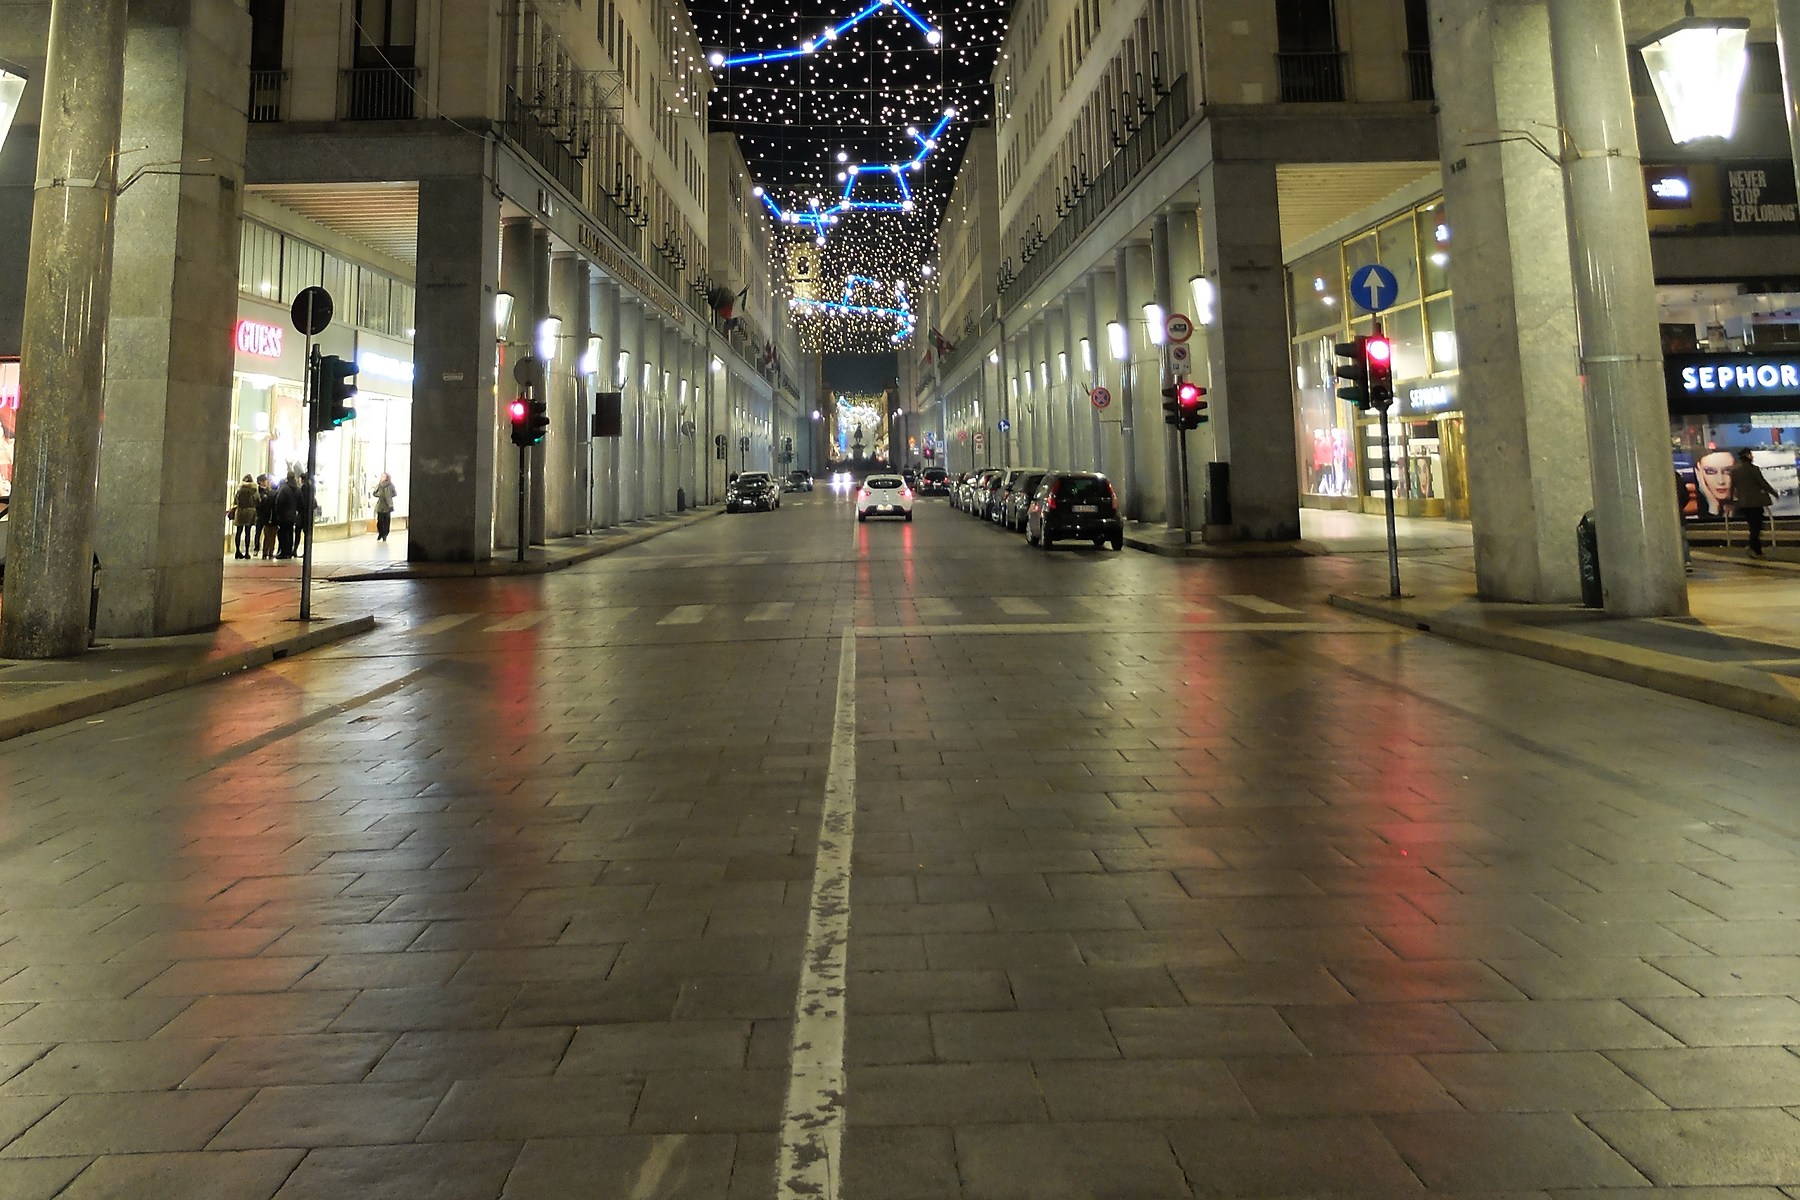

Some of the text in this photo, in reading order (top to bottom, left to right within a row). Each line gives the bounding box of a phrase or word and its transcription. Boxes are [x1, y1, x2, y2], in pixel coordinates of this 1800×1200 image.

[1728, 170, 1767, 188] NEVER
[1731, 188, 1760, 205] STOP
[1733, 204, 1796, 222] EXPLORING
[236, 320, 283, 358] GUESS
